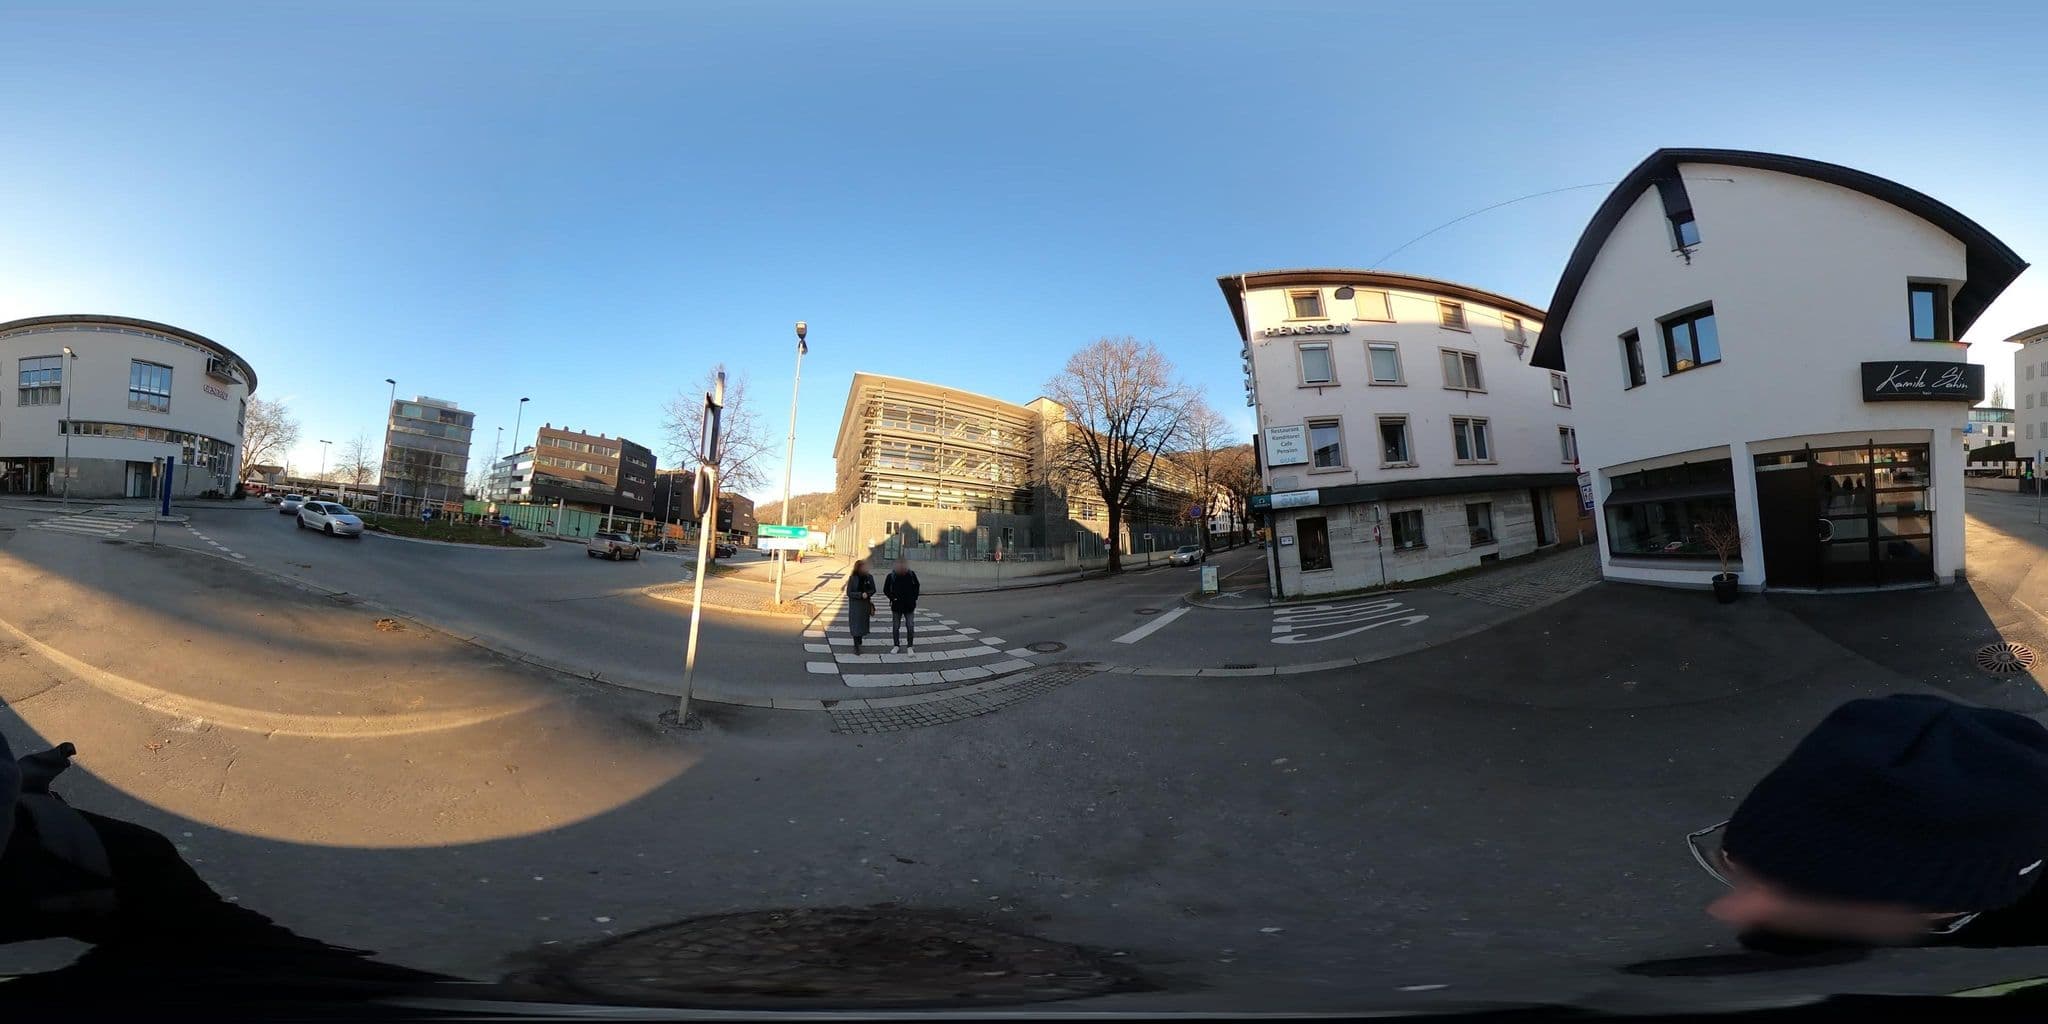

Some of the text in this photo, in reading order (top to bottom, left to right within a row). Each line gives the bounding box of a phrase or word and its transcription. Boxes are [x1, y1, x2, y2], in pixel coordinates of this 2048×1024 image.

[1264, 322, 1350, 337] PENSION
[1876, 364, 1928, 392] Kamile
[1270, 426, 1300, 434] Restaurant
[1271, 433, 1301, 441] Konditorei
